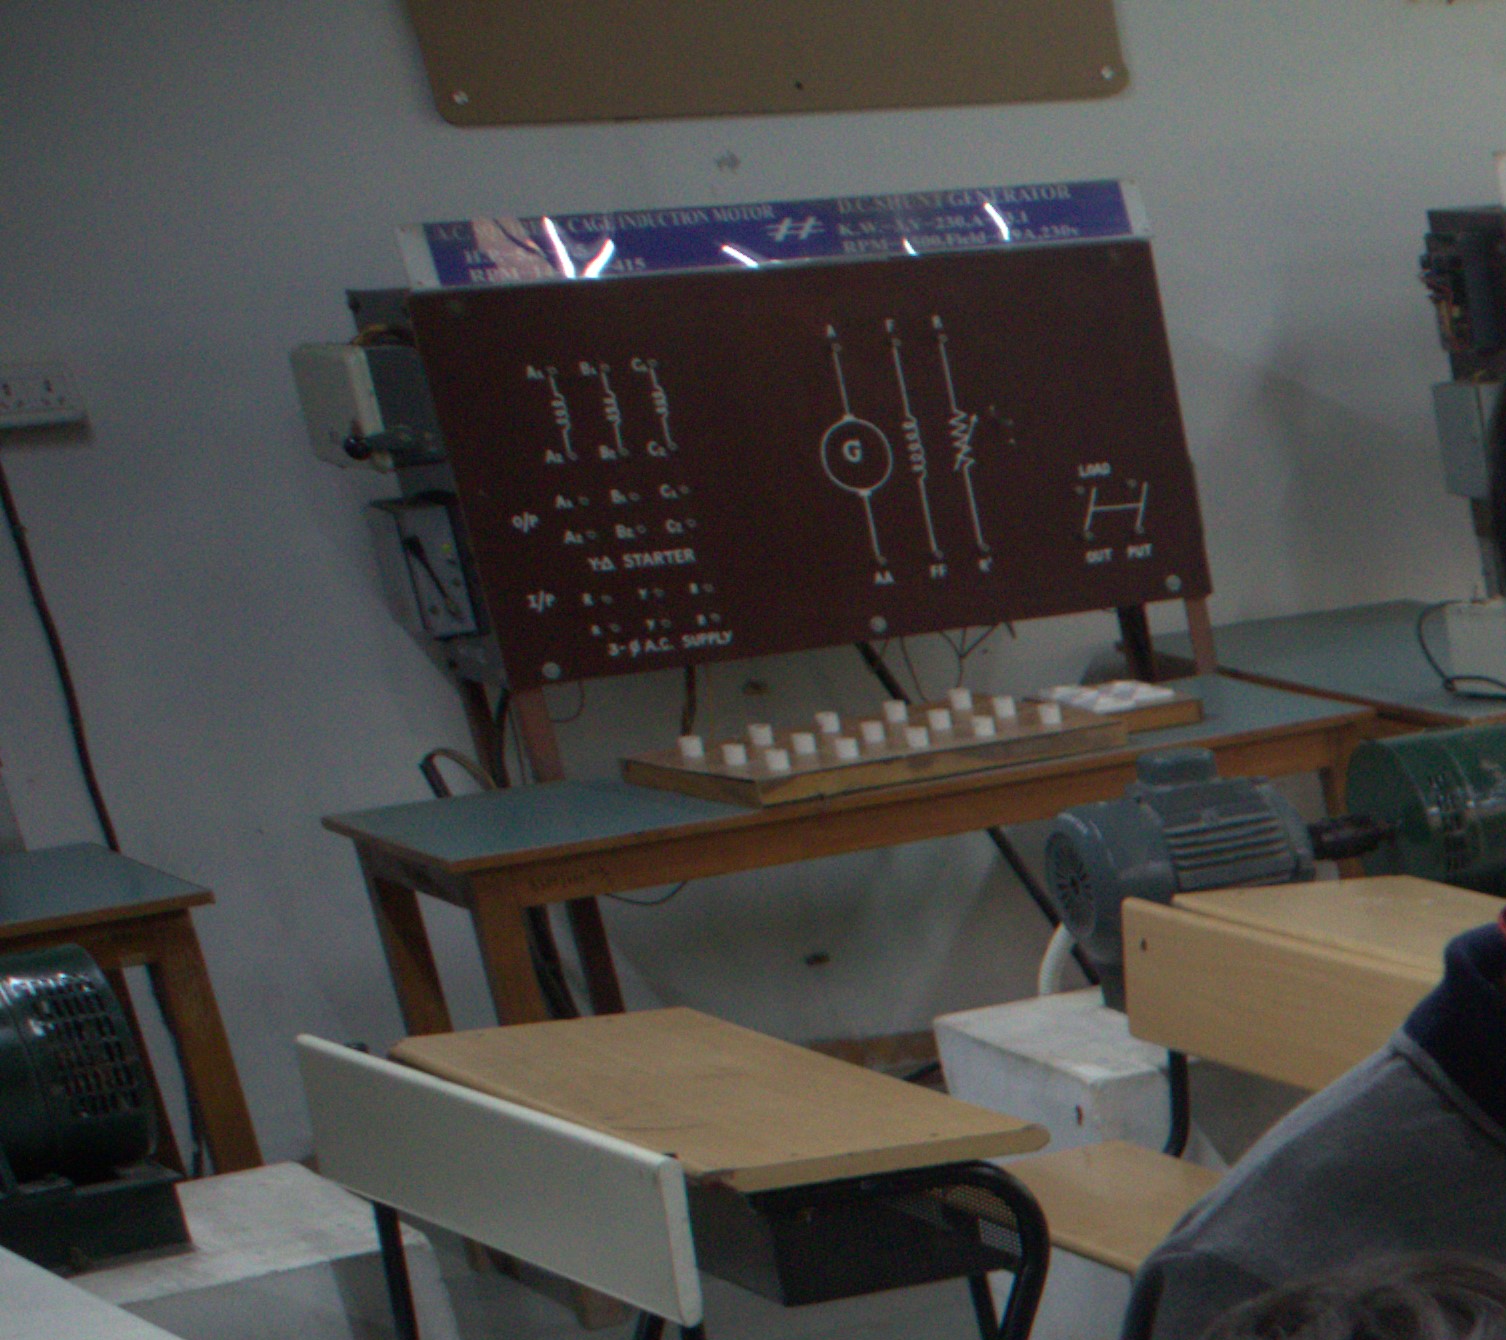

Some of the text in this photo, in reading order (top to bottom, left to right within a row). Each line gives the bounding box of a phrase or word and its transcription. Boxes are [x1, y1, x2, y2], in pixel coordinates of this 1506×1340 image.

[712, 203, 776, 224] MOTOR
[843, 439, 863, 464] G
[1077, 461, 1112, 479] LOAD
[511, 511, 540, 534] O/P
[622, 547, 697, 570] STARTER
[527, 590, 556, 613] I/P
[681, 629, 734, 650] SUPPLY
